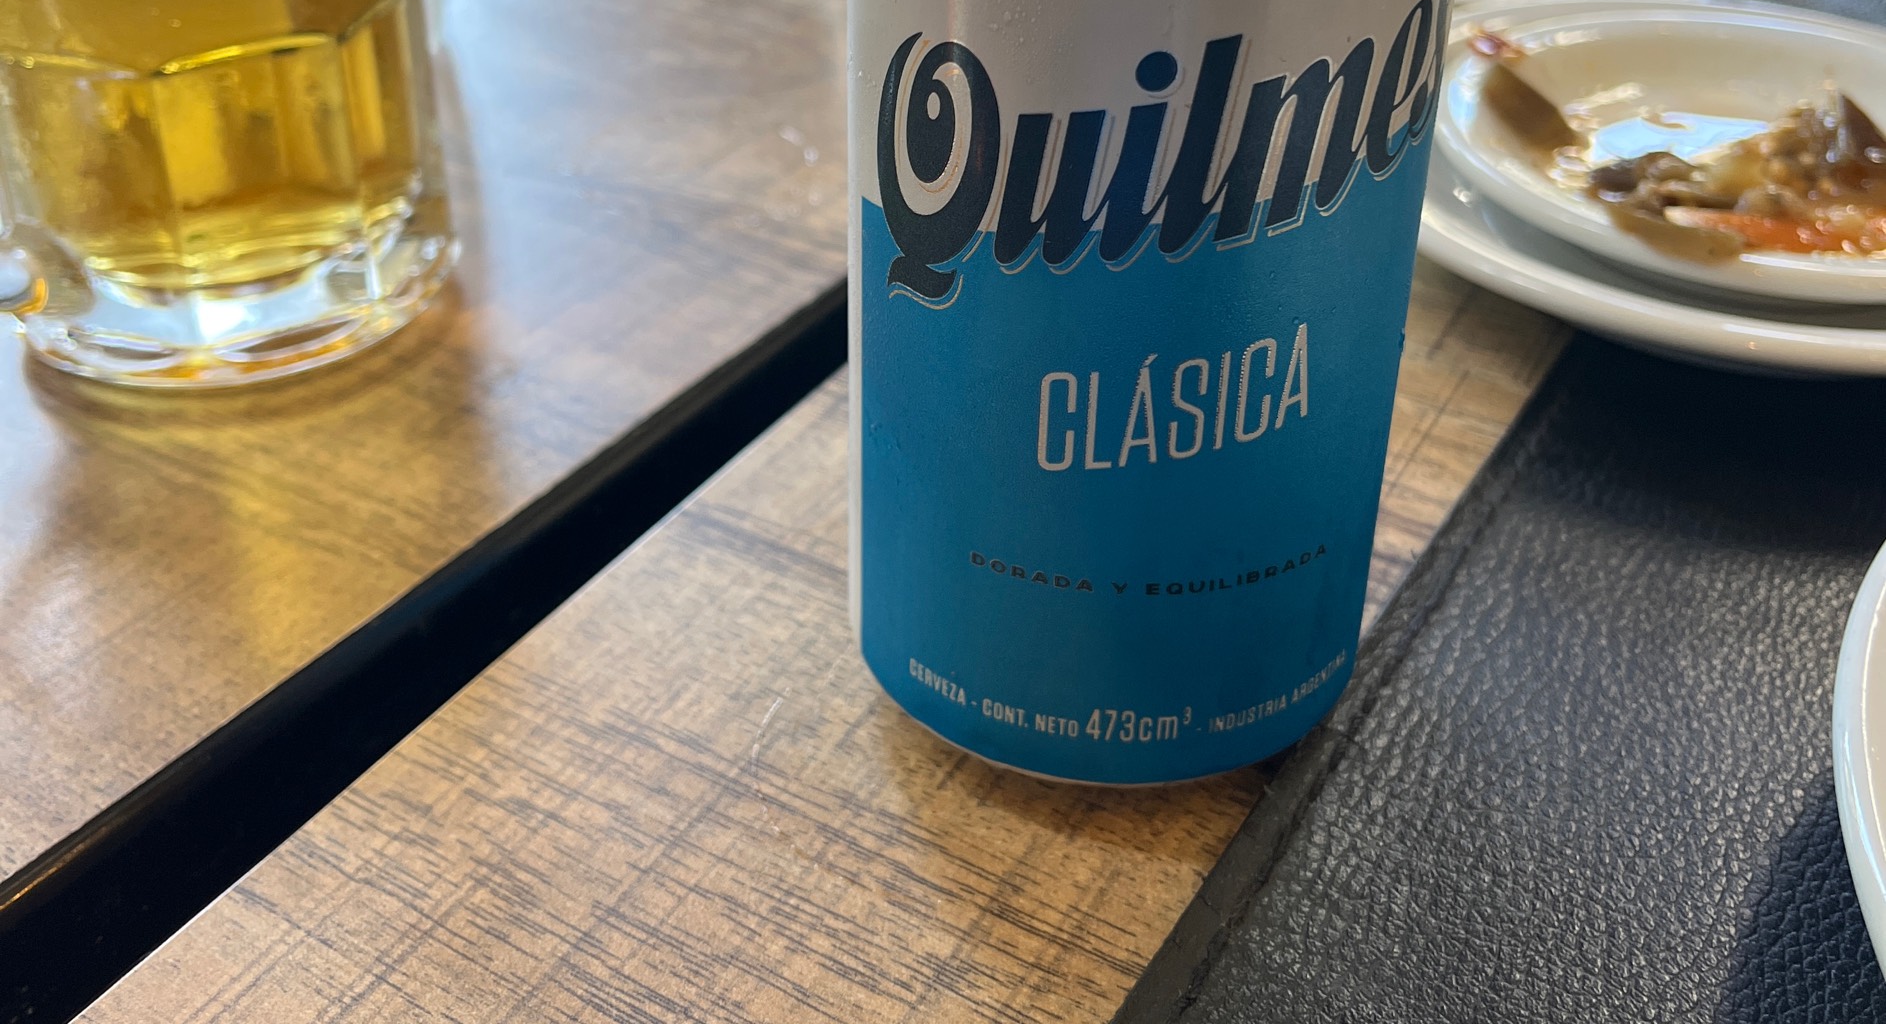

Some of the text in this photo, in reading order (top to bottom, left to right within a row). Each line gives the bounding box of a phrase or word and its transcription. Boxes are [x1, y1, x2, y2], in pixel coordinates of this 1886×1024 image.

[1036, 322, 1309, 473] CLÁSICA
[969, 544, 1327, 596] DORADA Y EQUILIBRADA
[908, 657, 967, 707] CERVEZA
[982, 698, 1029, 728] CONT.
[1035, 713, 1079, 738] NETO
[1208, 693, 1287, 734] INDUSTRIA
[1291, 647, 1347, 704] ARGENTINA
